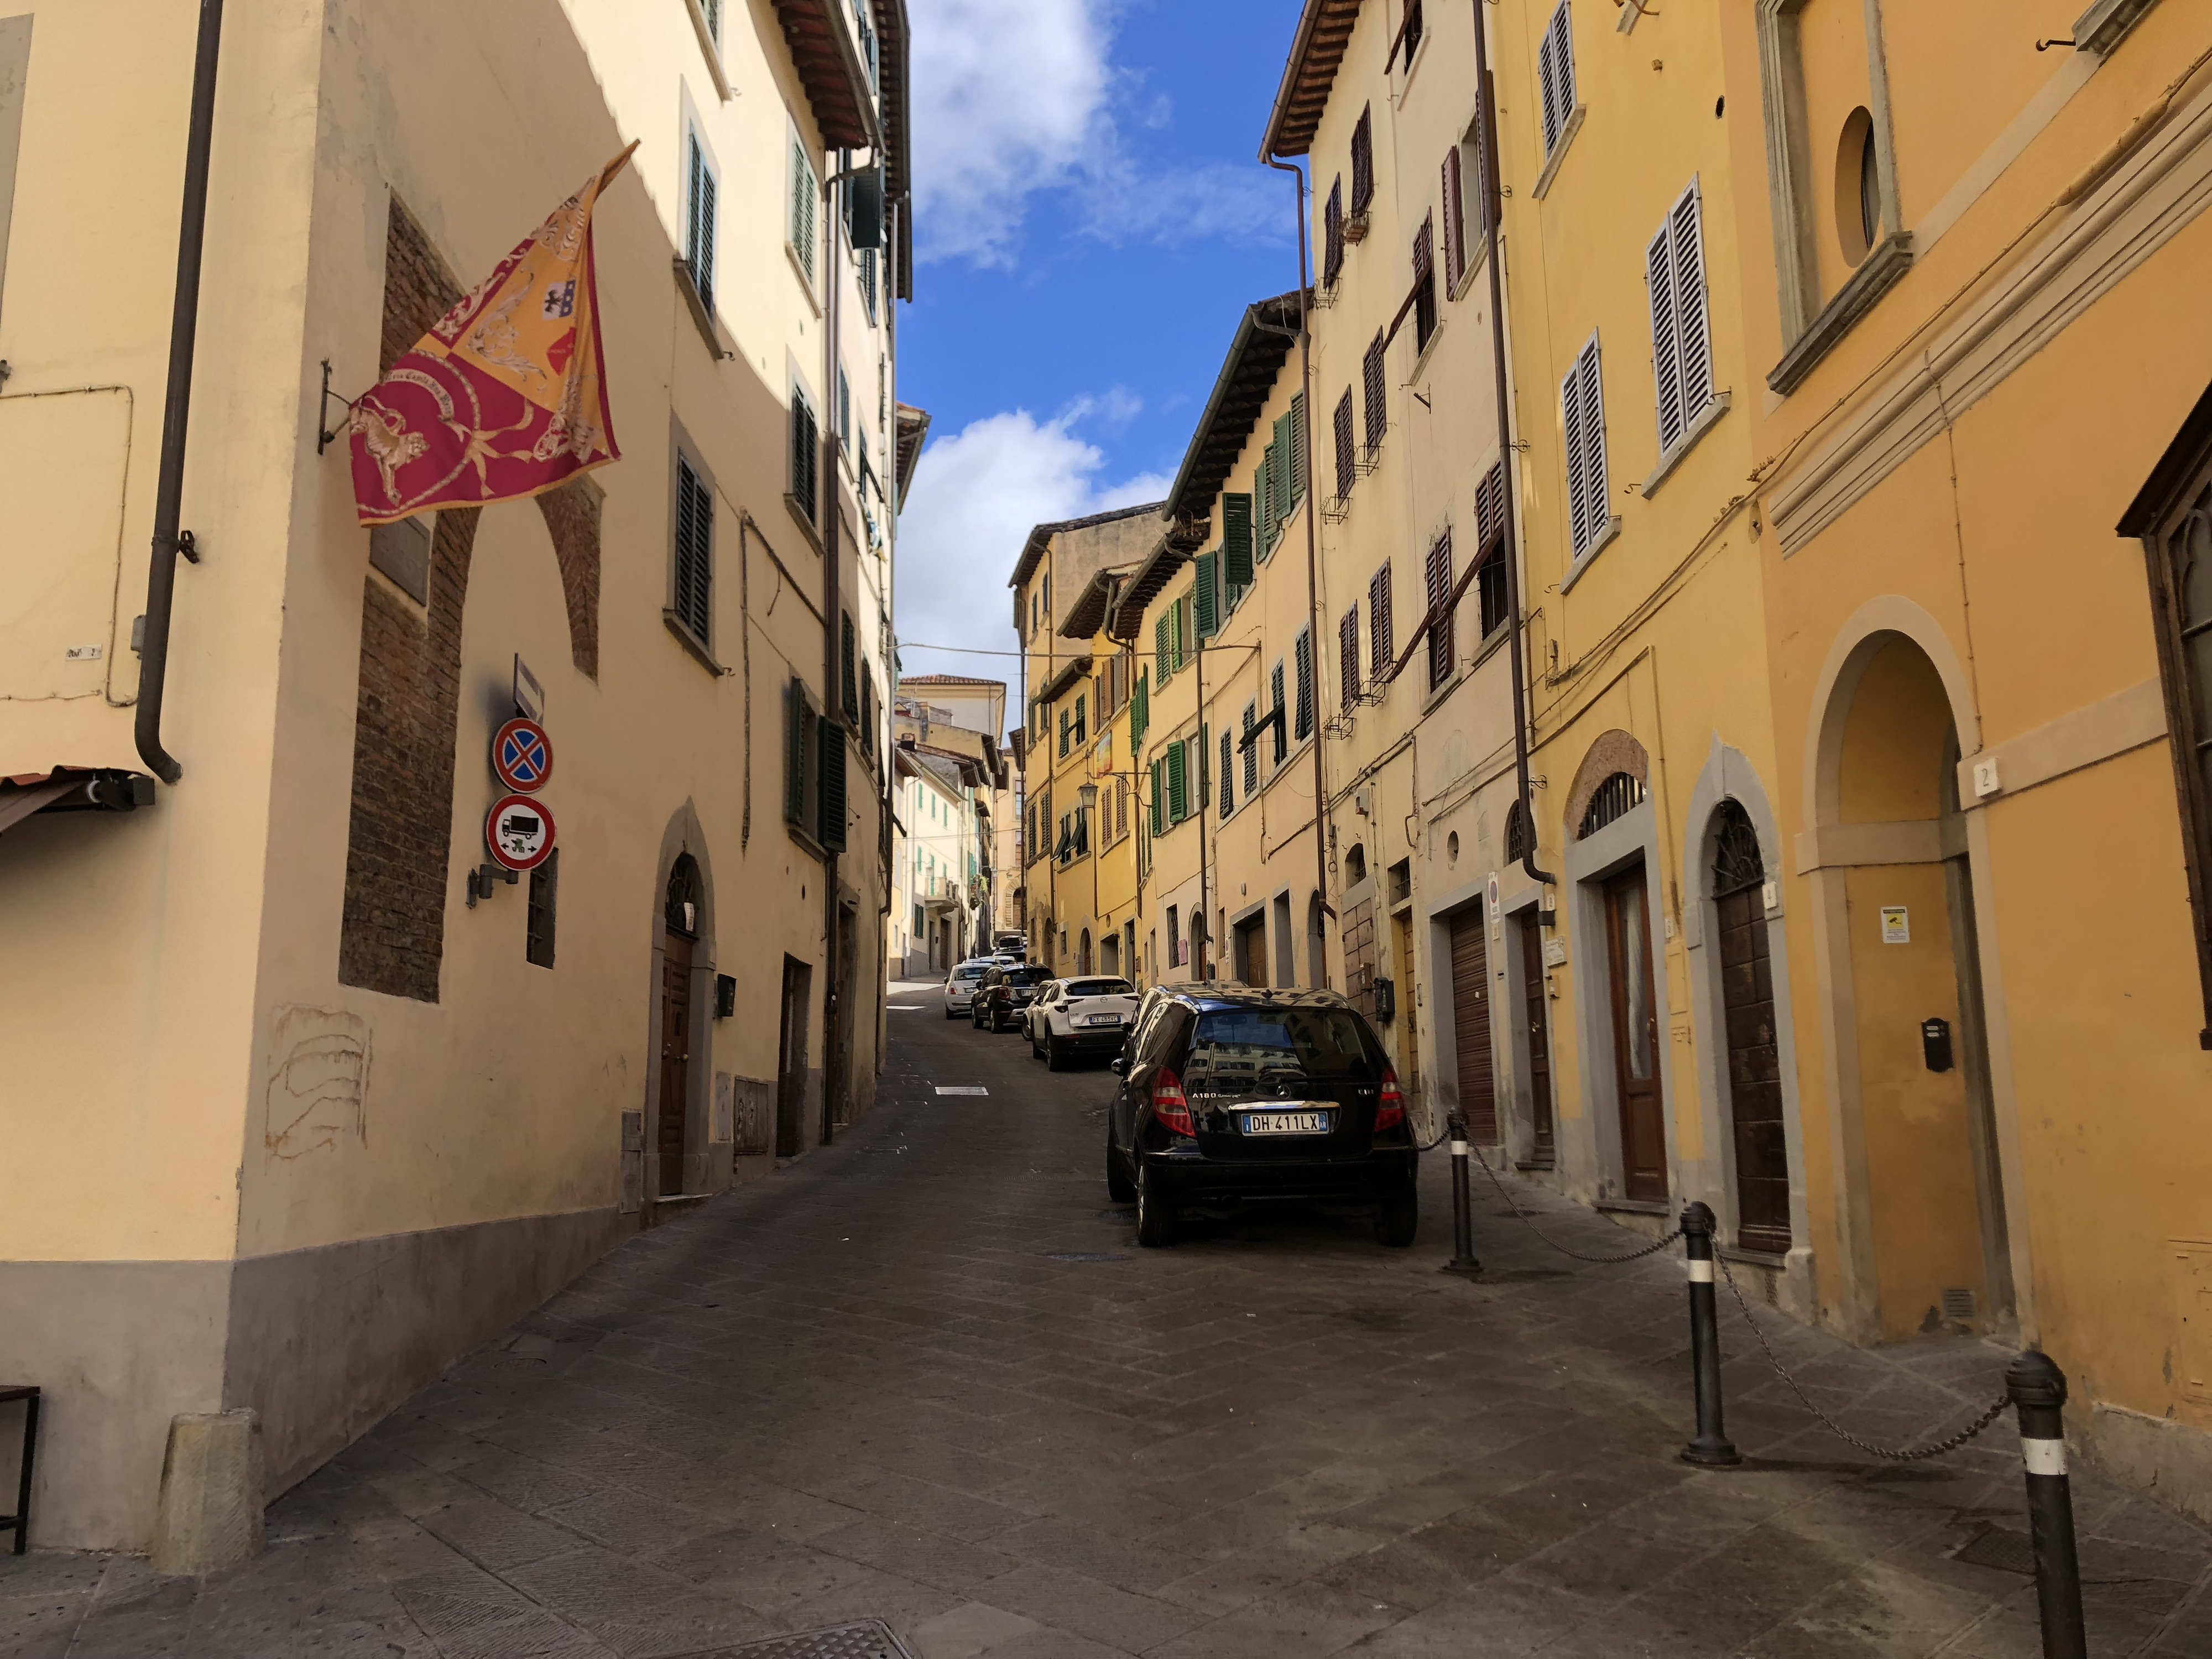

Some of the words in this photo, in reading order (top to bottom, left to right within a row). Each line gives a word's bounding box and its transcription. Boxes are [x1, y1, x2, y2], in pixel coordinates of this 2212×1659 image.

[1980, 768, 1989, 787] 2
[1253, 1116, 1270, 1131] DH
[1275, 1115, 1318, 1130] 411LX
